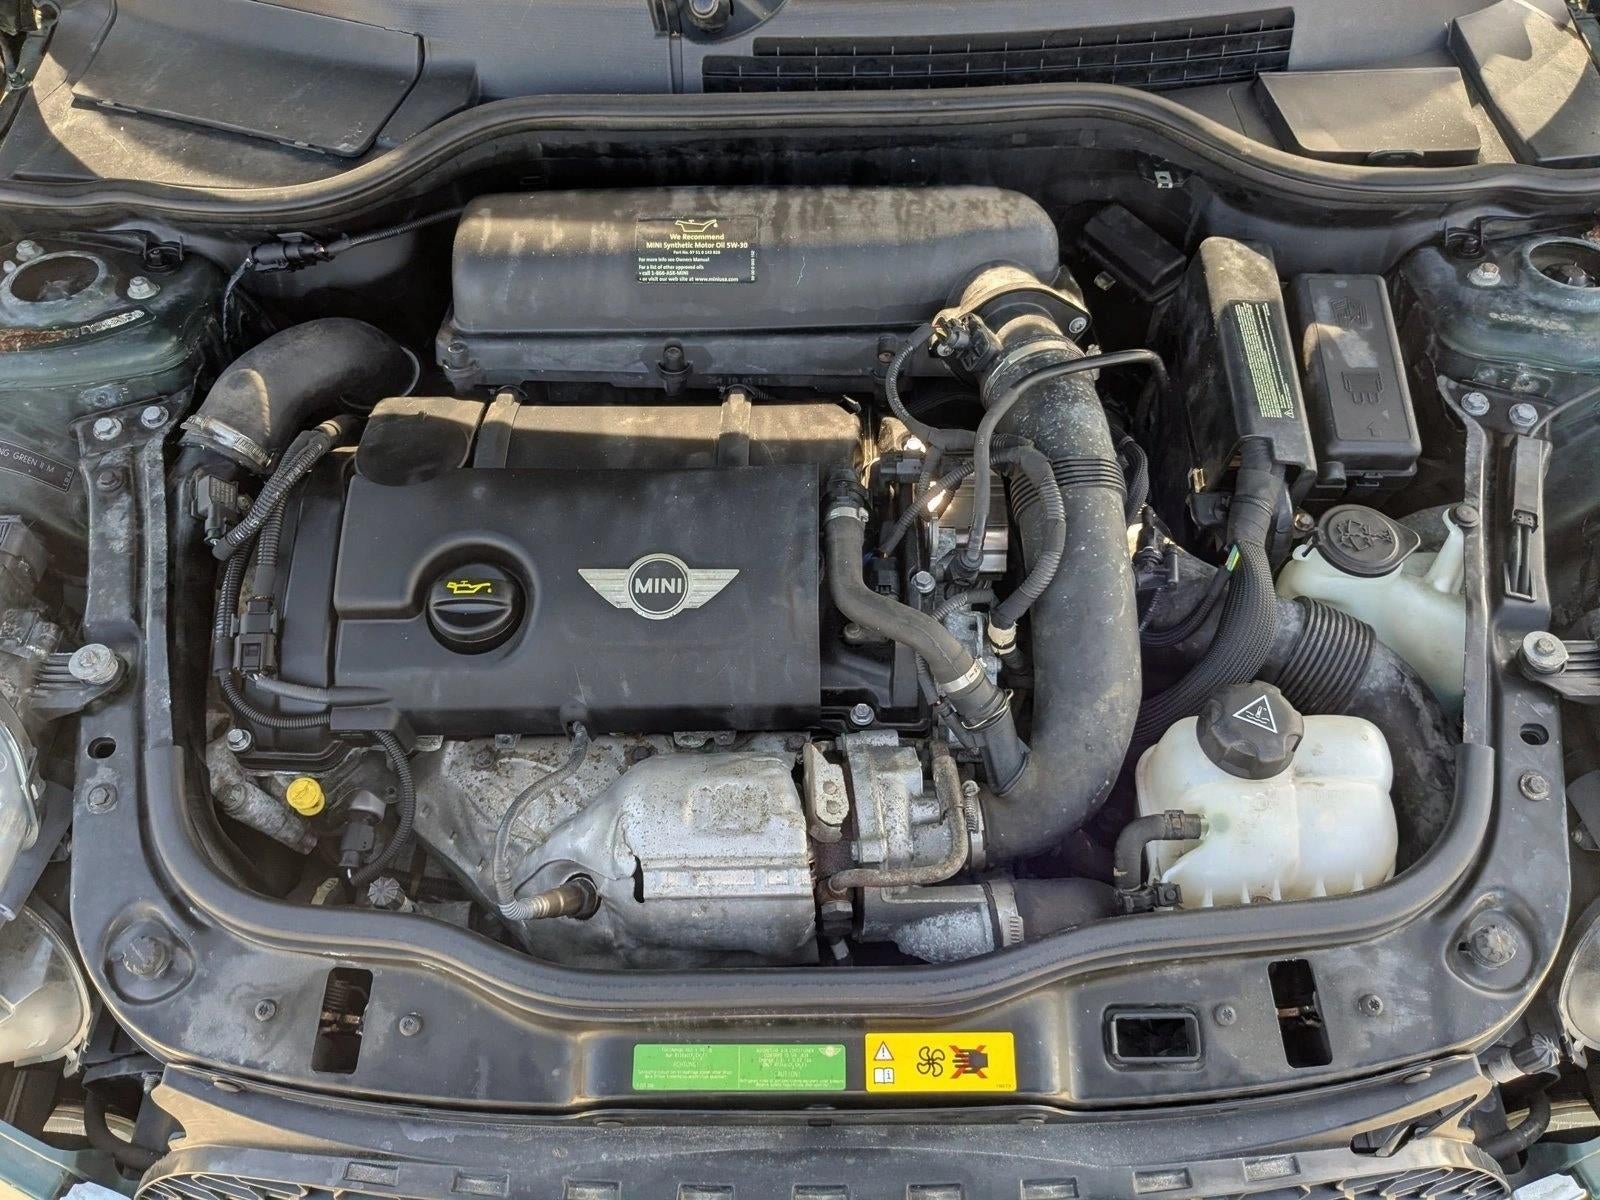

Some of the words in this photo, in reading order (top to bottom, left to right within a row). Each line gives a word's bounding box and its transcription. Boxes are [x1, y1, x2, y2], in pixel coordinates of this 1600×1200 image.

[663, 241, 693, 250] Synthetic
[13, 451, 38, 467] GREEN
[635, 577, 683, 594] MINI
